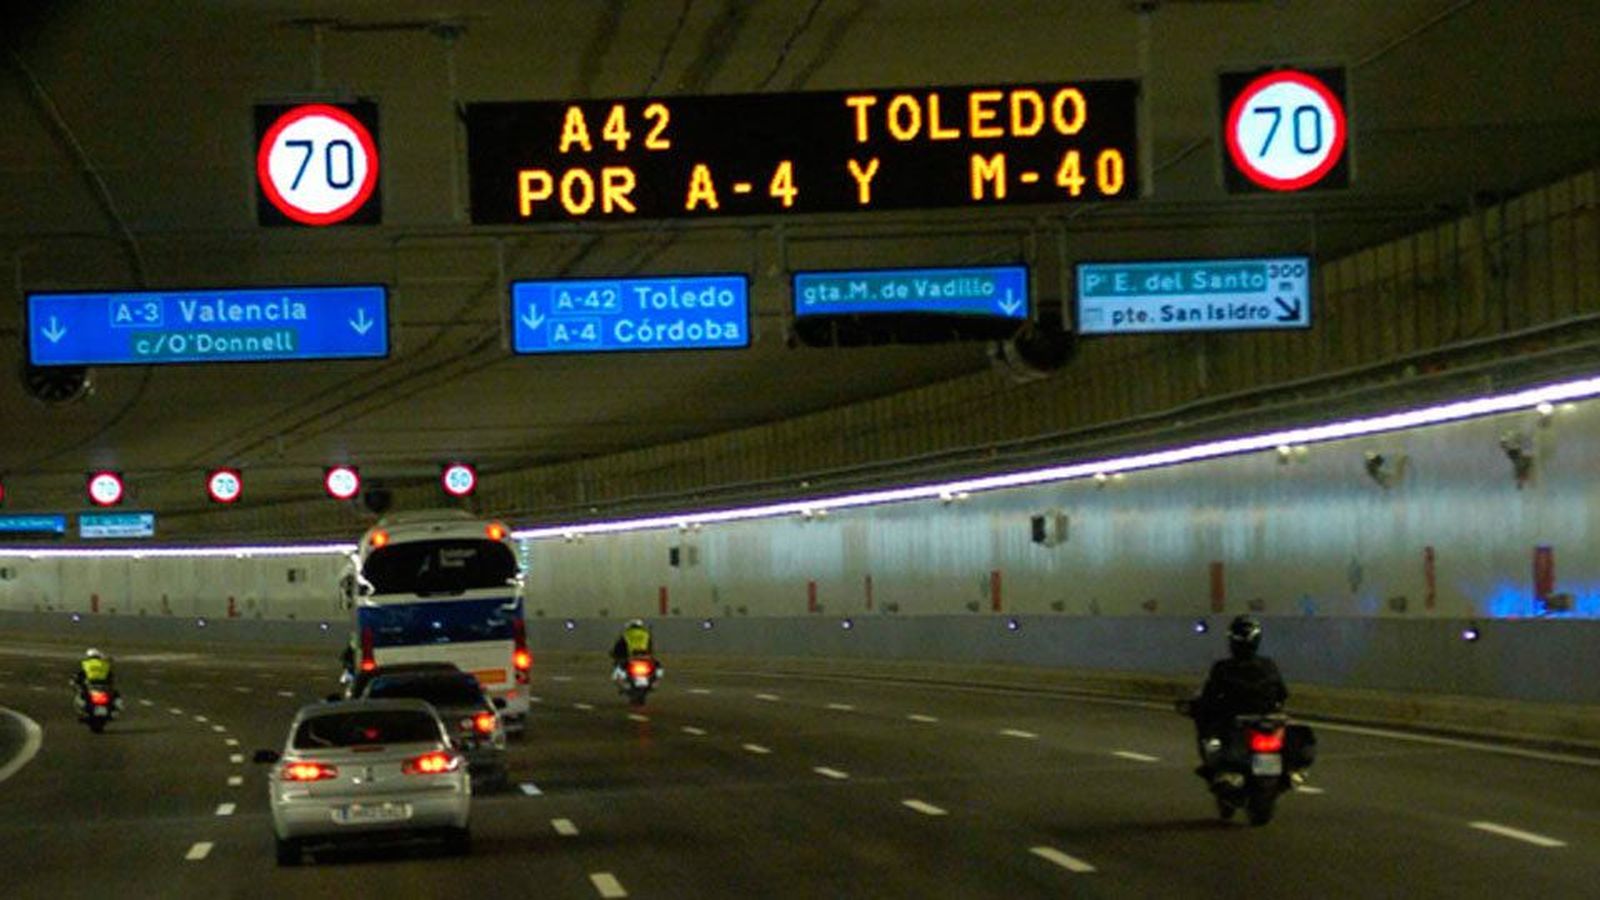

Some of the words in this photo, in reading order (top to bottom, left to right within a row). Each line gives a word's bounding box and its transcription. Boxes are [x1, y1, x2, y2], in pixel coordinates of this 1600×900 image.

[560, 104, 671, 153] A42
[846, 88, 1086, 142] TOLEDO
[1253, 104, 1323, 158] 70
[284, 139, 354, 191] 70
[518, 165, 637, 216] POR
[685, 160, 798, 210] A-4
[848, 157, 879, 204] Y
[970, 149, 1124, 200] M-40
[1145, 271, 1184, 291] del
[1192, 269, 1264, 289] Santo
[1269, 263, 1306, 279] 300
[557, 290, 617, 309] A-42
[634, 286, 735, 310] Toledo
[912, 277, 995, 298] Vadillo
[115, 301, 160, 323] A-3
[179, 297, 307, 323] Valencia
[1160, 304, 1201, 323] San
[1207, 302, 1271, 321] Isidro
[554, 323, 597, 343] A-4
[614, 317, 740, 343] Córdoba
